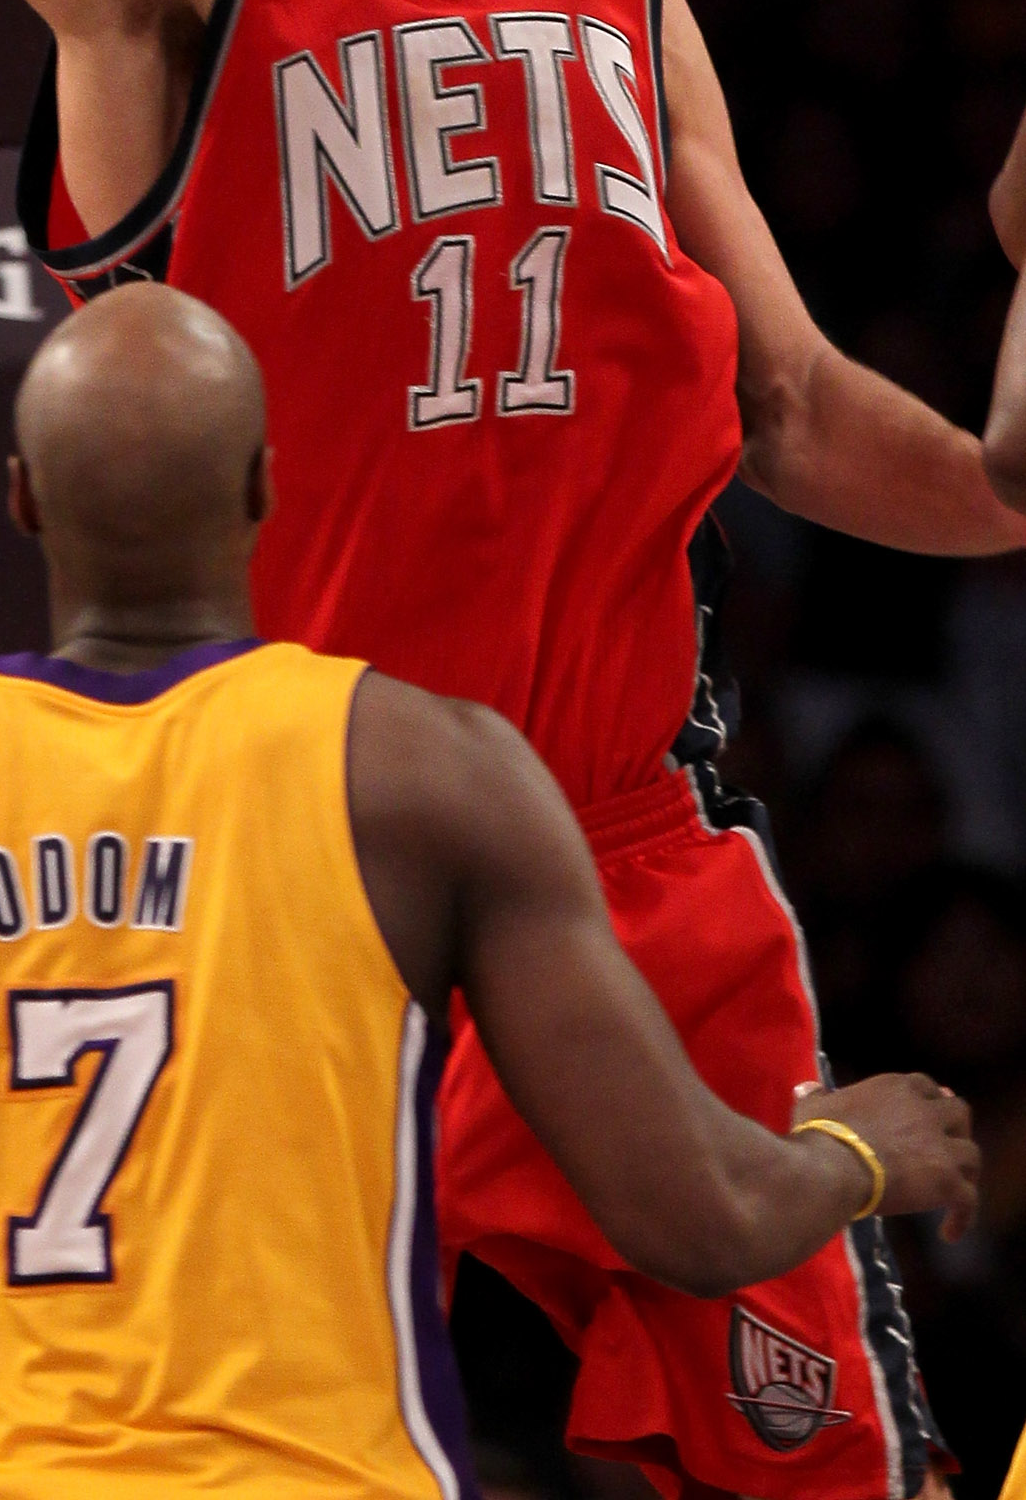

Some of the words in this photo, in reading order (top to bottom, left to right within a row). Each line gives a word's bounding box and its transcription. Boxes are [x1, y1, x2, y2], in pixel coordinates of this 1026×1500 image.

[274, 10, 674, 293] NETS
[406, 225, 575, 431] 11
[7, 979, 174, 1286] 7
[739, 1317, 830, 1408] NETS
